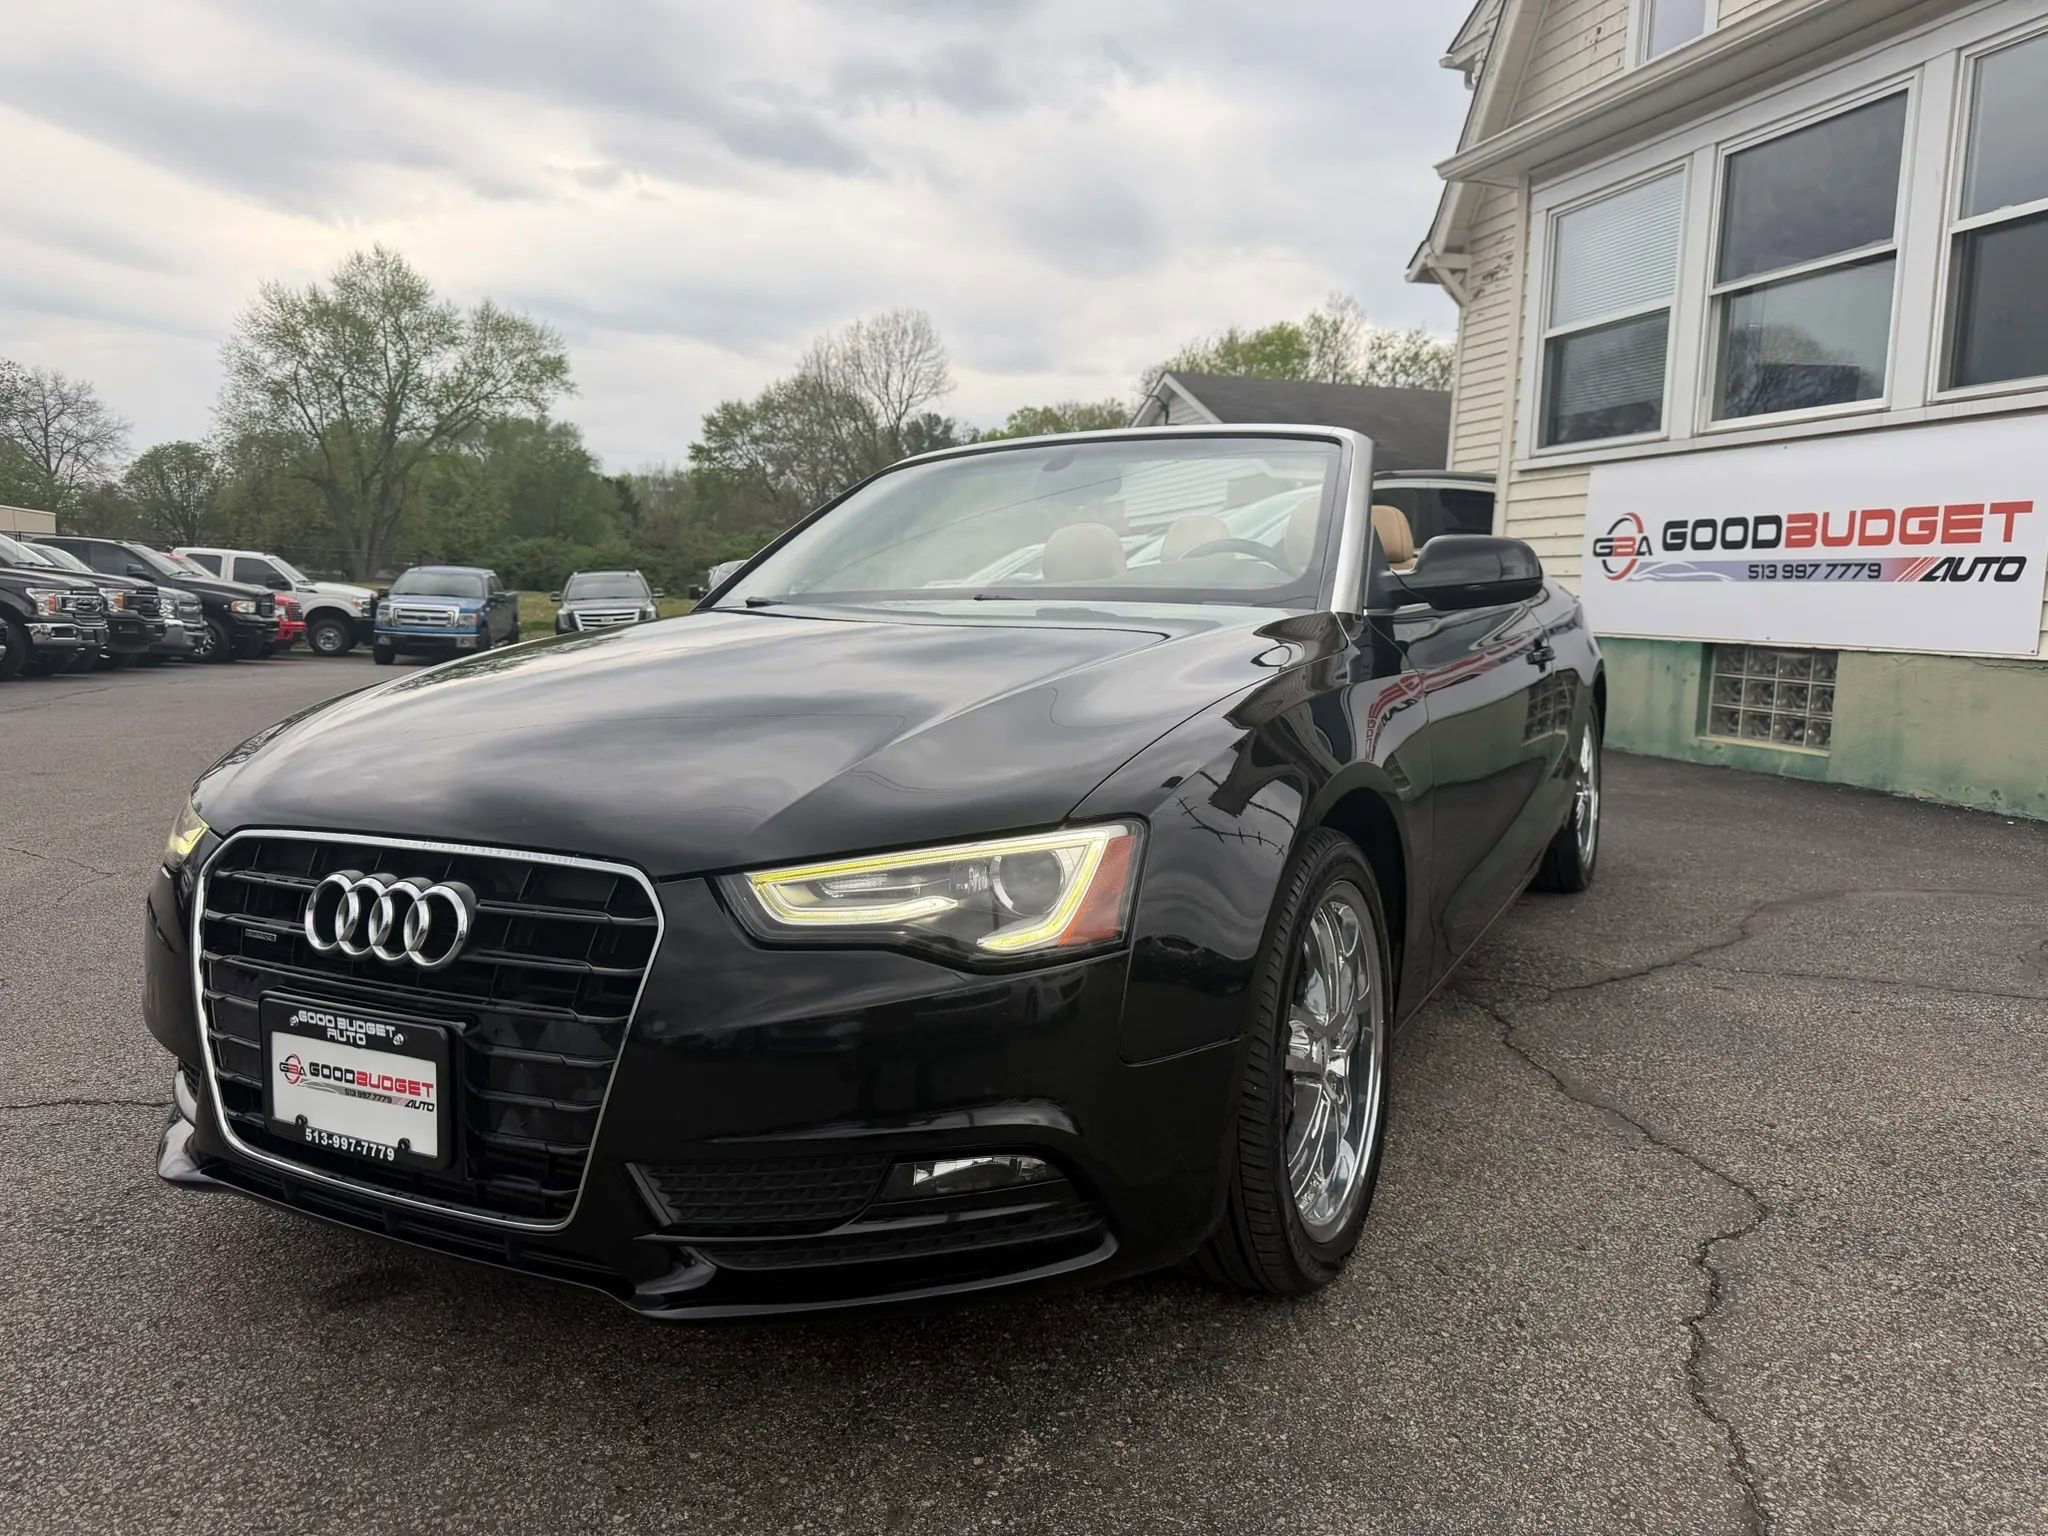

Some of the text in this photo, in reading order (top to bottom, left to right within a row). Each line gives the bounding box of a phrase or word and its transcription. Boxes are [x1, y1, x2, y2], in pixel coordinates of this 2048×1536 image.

[1592, 534, 1653, 558] GBA
[1748, 562, 1882, 580] 513 997 7779
[1918, 555, 2028, 583] AUTO
[298, 1010, 396, 1038] GOOD BUDGET
[326, 1028, 366, 1046] AUTO
[344, 1088, 393, 1104] 513 997 7779
[404, 1099, 435, 1113] AUTO
[305, 1128, 395, 1162] 513-997-7779
